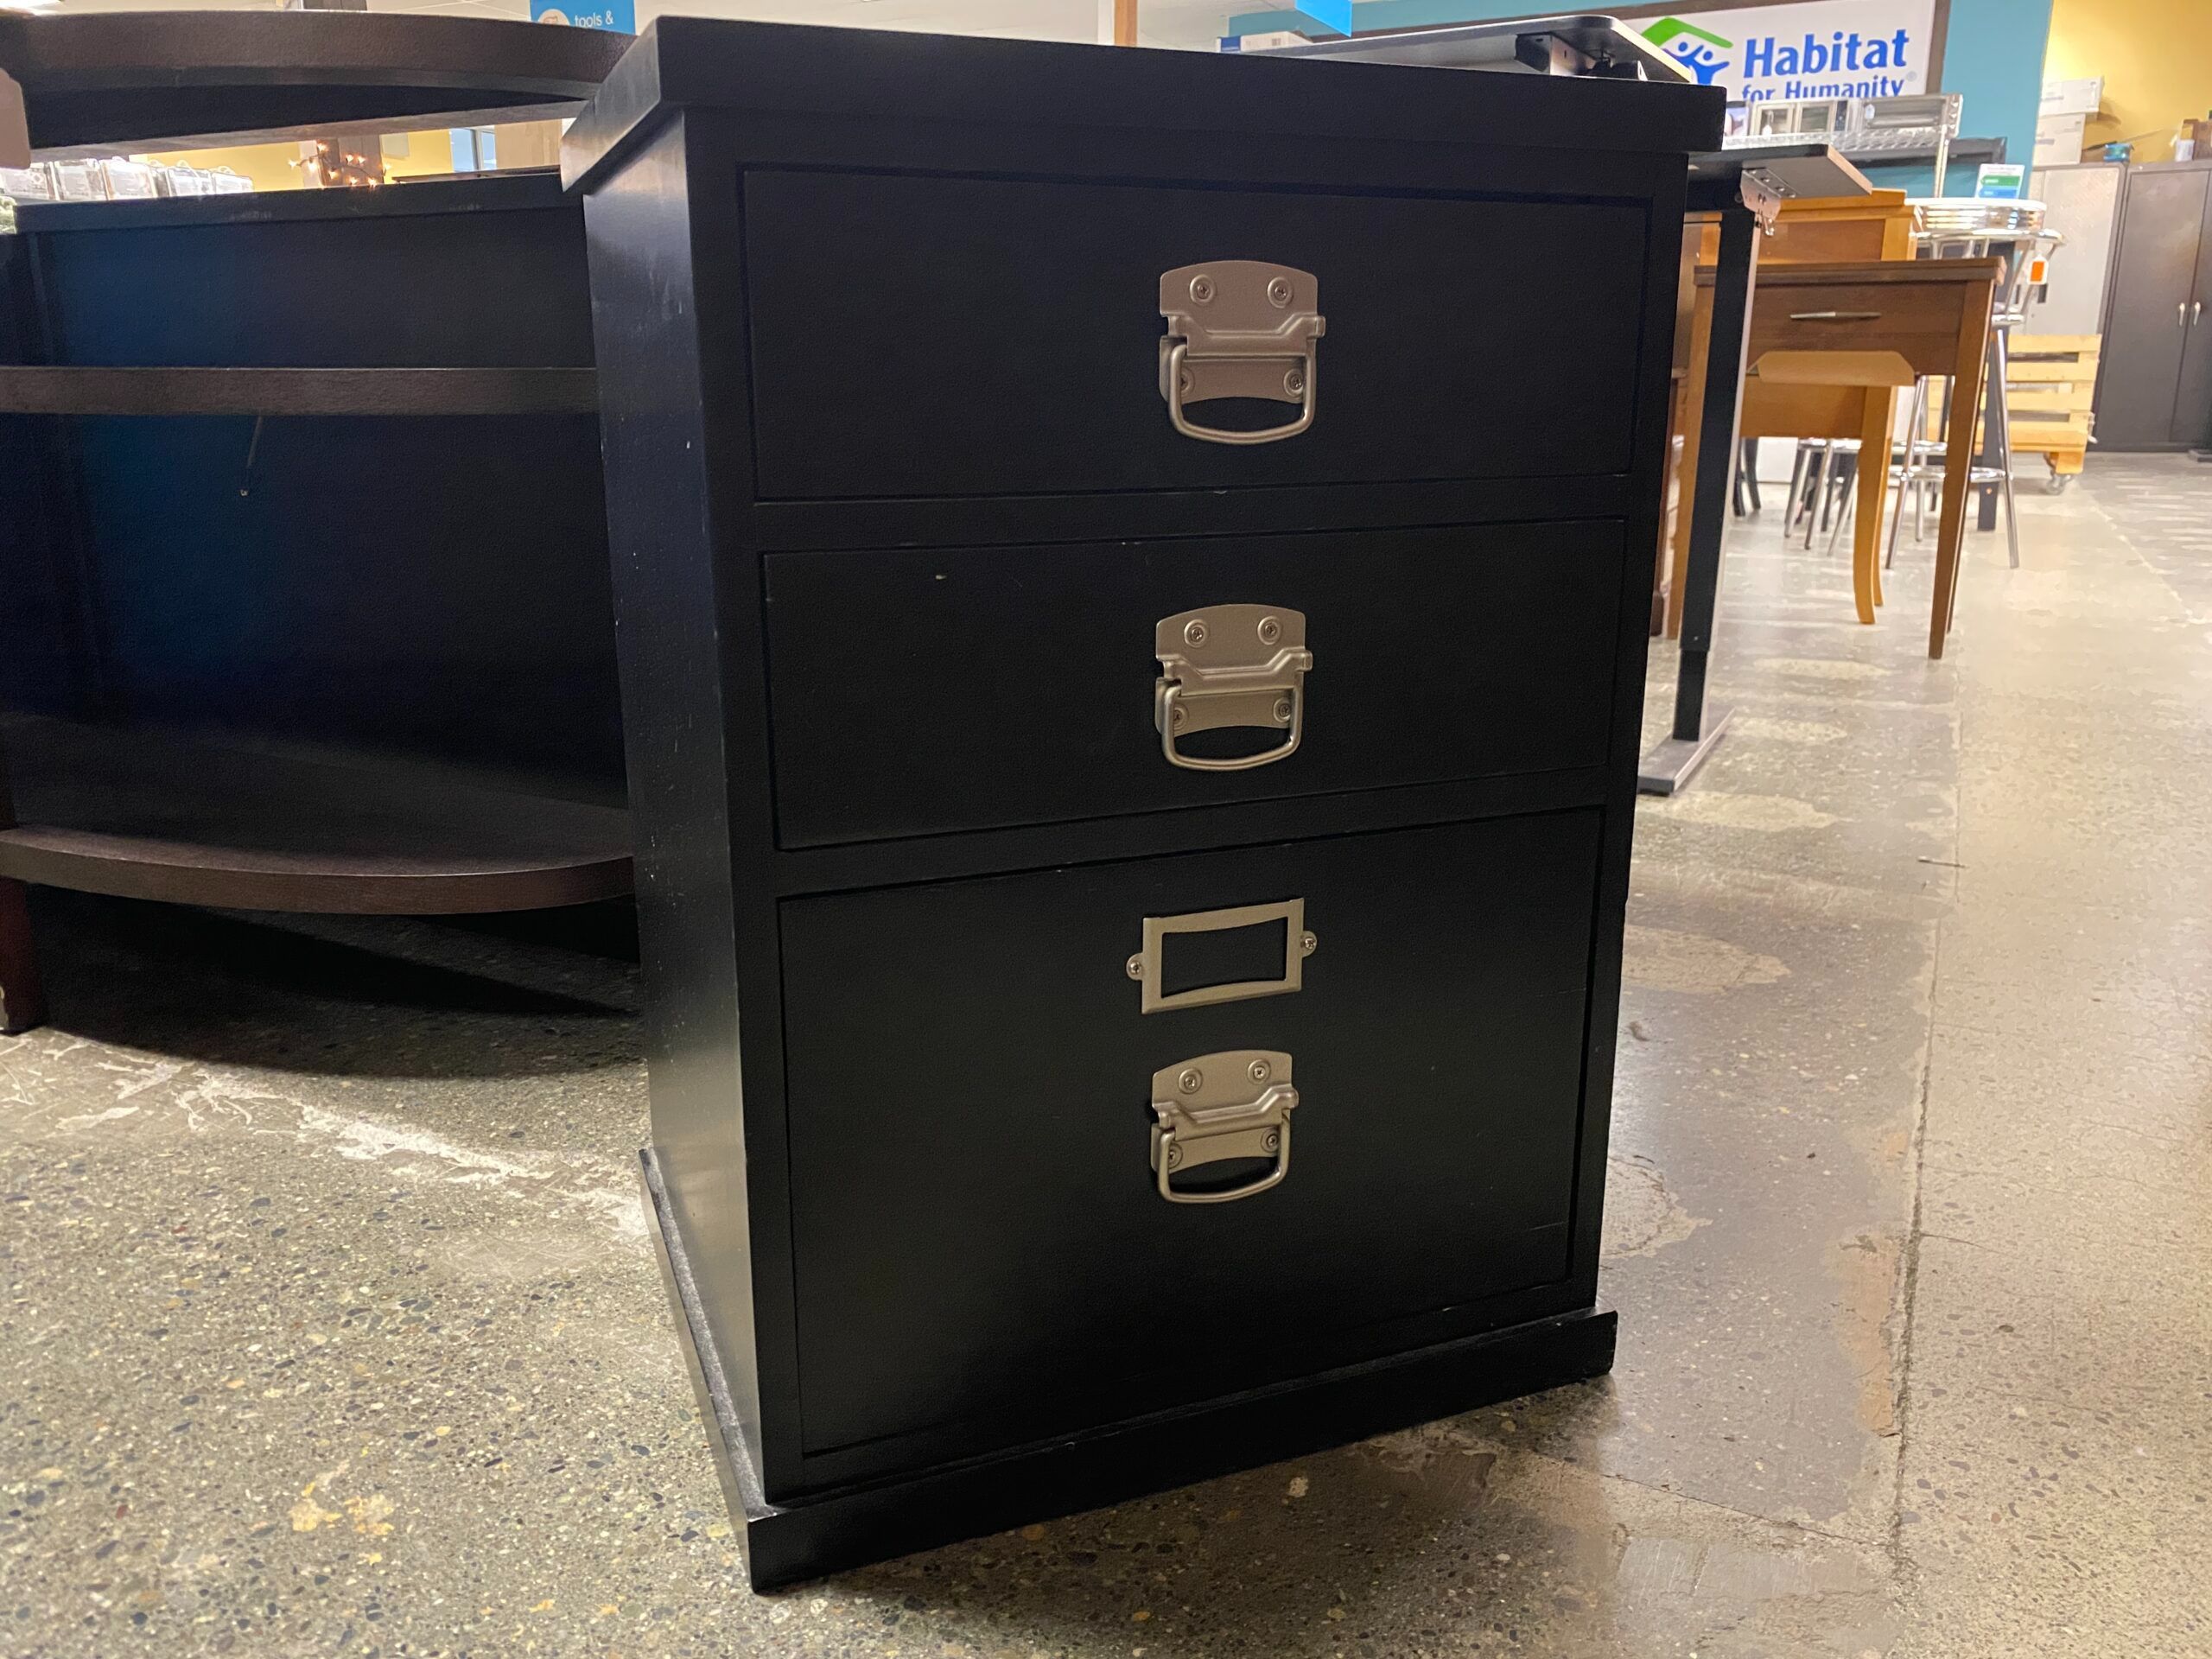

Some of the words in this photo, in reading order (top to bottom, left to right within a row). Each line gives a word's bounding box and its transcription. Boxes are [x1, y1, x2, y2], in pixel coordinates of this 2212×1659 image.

[575, 13, 603, 28] tools
[606, 10, 614, 25] &
[1744, 29, 1910, 79] Habitat
[1742, 85, 1776, 102] for
[1785, 74, 1904, 99] Humanity
